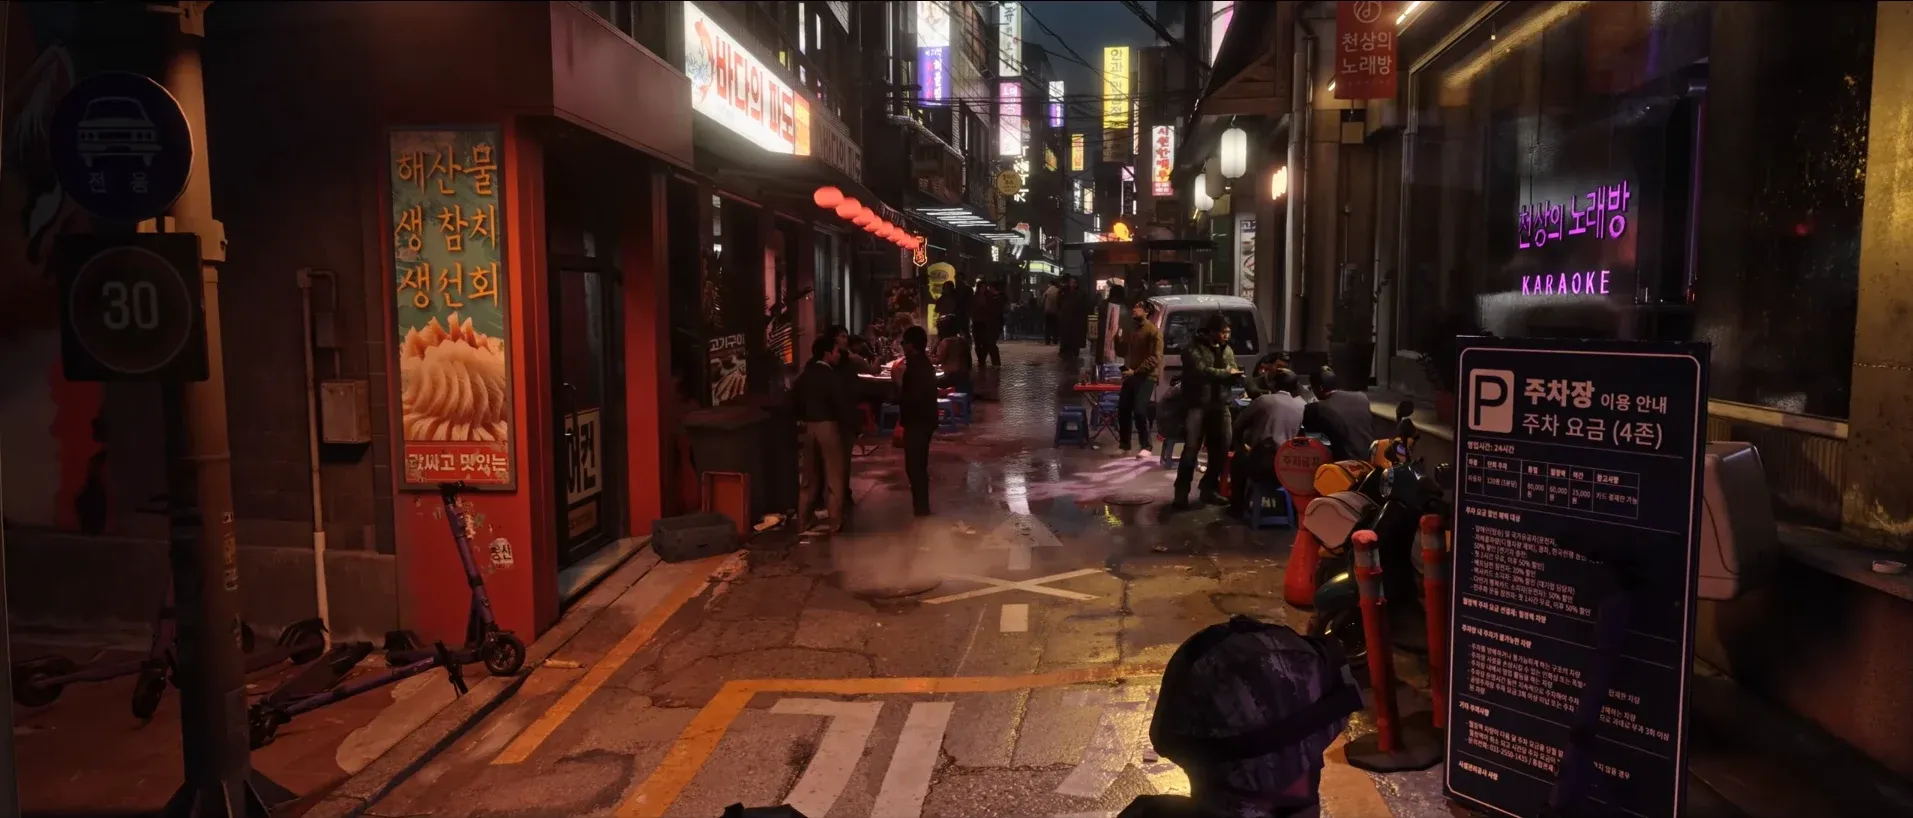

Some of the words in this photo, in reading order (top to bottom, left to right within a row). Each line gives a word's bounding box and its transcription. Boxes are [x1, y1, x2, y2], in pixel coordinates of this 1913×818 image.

[1341, 32, 1392, 53] 천상의
[714, 36, 764, 121] 바다의
[1341, 54, 1392, 75] 노래방
[395, 143, 498, 196] 해산물
[395, 207, 424, 252] 생
[438, 203, 497, 252] 참치
[1518, 200, 1564, 250] 천상의
[1568, 180, 1630, 239] 노래방
[397, 262, 500, 310] 생선회
[1522, 270, 1610, 296] KARAOKE
[102, 281, 160, 330] 30
[710, 333, 745, 351] 고기구이
[1475, 374, 1509, 426] P
[1524, 378, 1596, 409] 주차장
[1600, 392, 1630, 412] 이용
[1636, 395, 1668, 414] 안내
[1494, 444, 1514, 454] 24시간
[1522, 413, 1560, 436] 주차
[1566, 417, 1606, 441] 요금
[1612, 420, 1663, 450] (4존)
